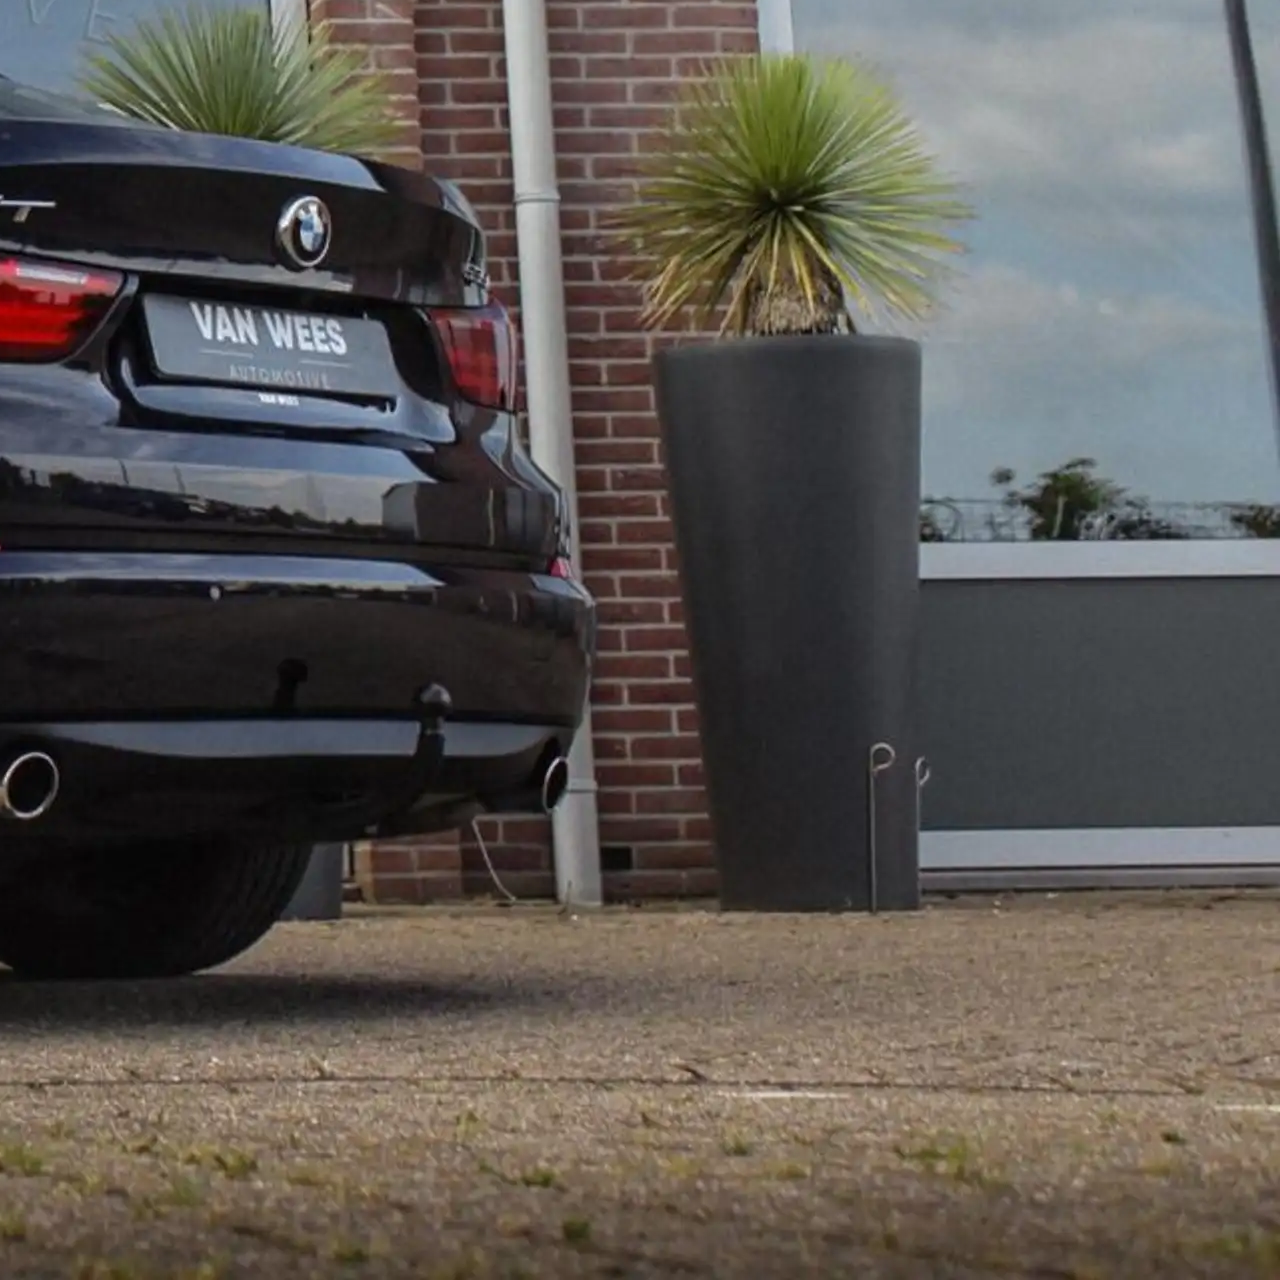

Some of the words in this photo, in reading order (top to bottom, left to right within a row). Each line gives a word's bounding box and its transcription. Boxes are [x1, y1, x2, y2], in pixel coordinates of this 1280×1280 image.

[190, 301, 259, 346] VAN
[262, 310, 348, 355] WEES
[229, 365, 332, 390] AUTOMOTIVE
